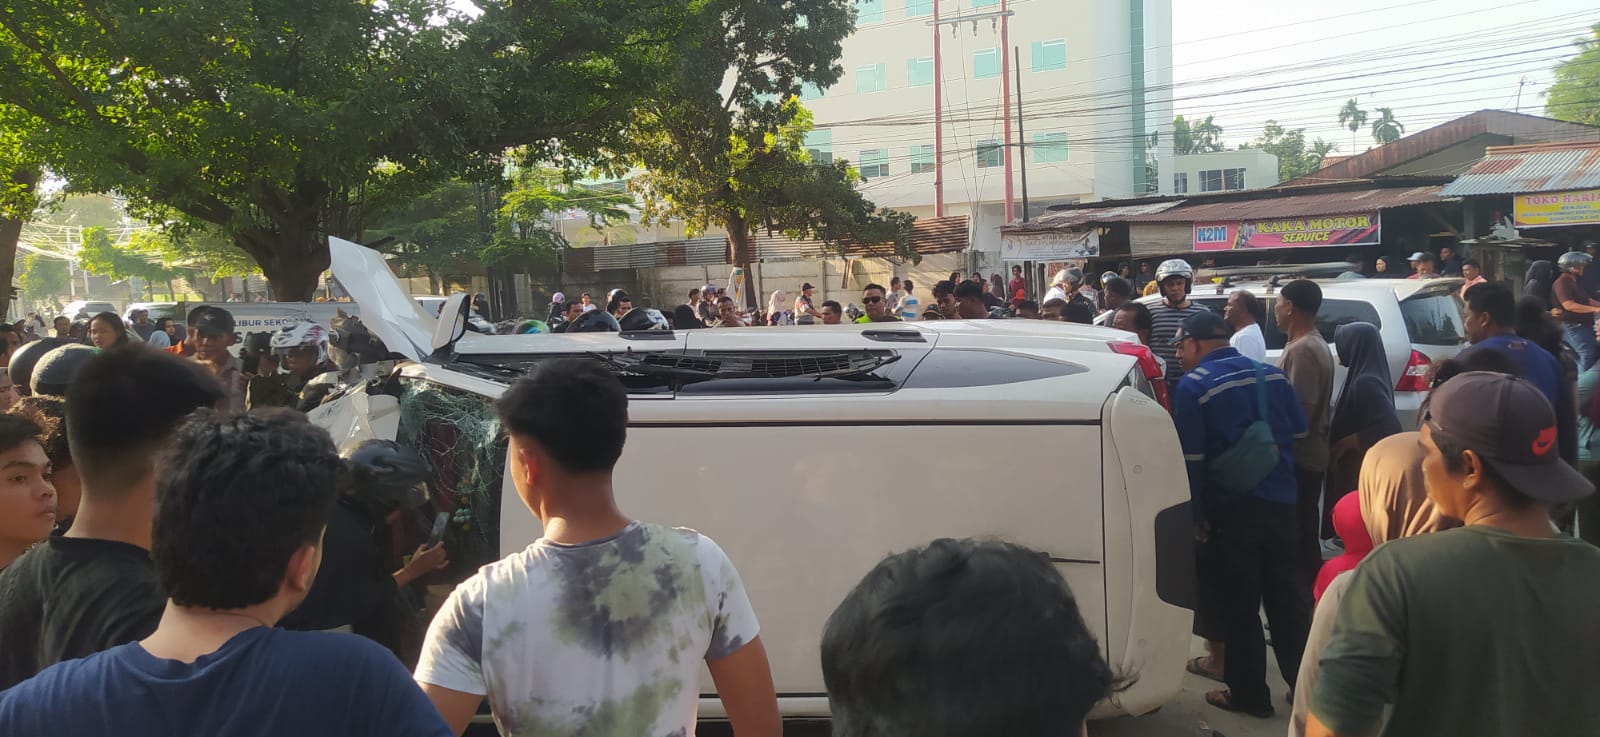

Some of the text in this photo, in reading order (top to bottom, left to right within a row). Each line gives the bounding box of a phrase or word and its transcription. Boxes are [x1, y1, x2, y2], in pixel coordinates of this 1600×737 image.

[1526, 196, 1559, 205] TOKO
[1257, 215, 1369, 232] KAKA MOTOR
[1281, 231, 1330, 243] SERVICE
